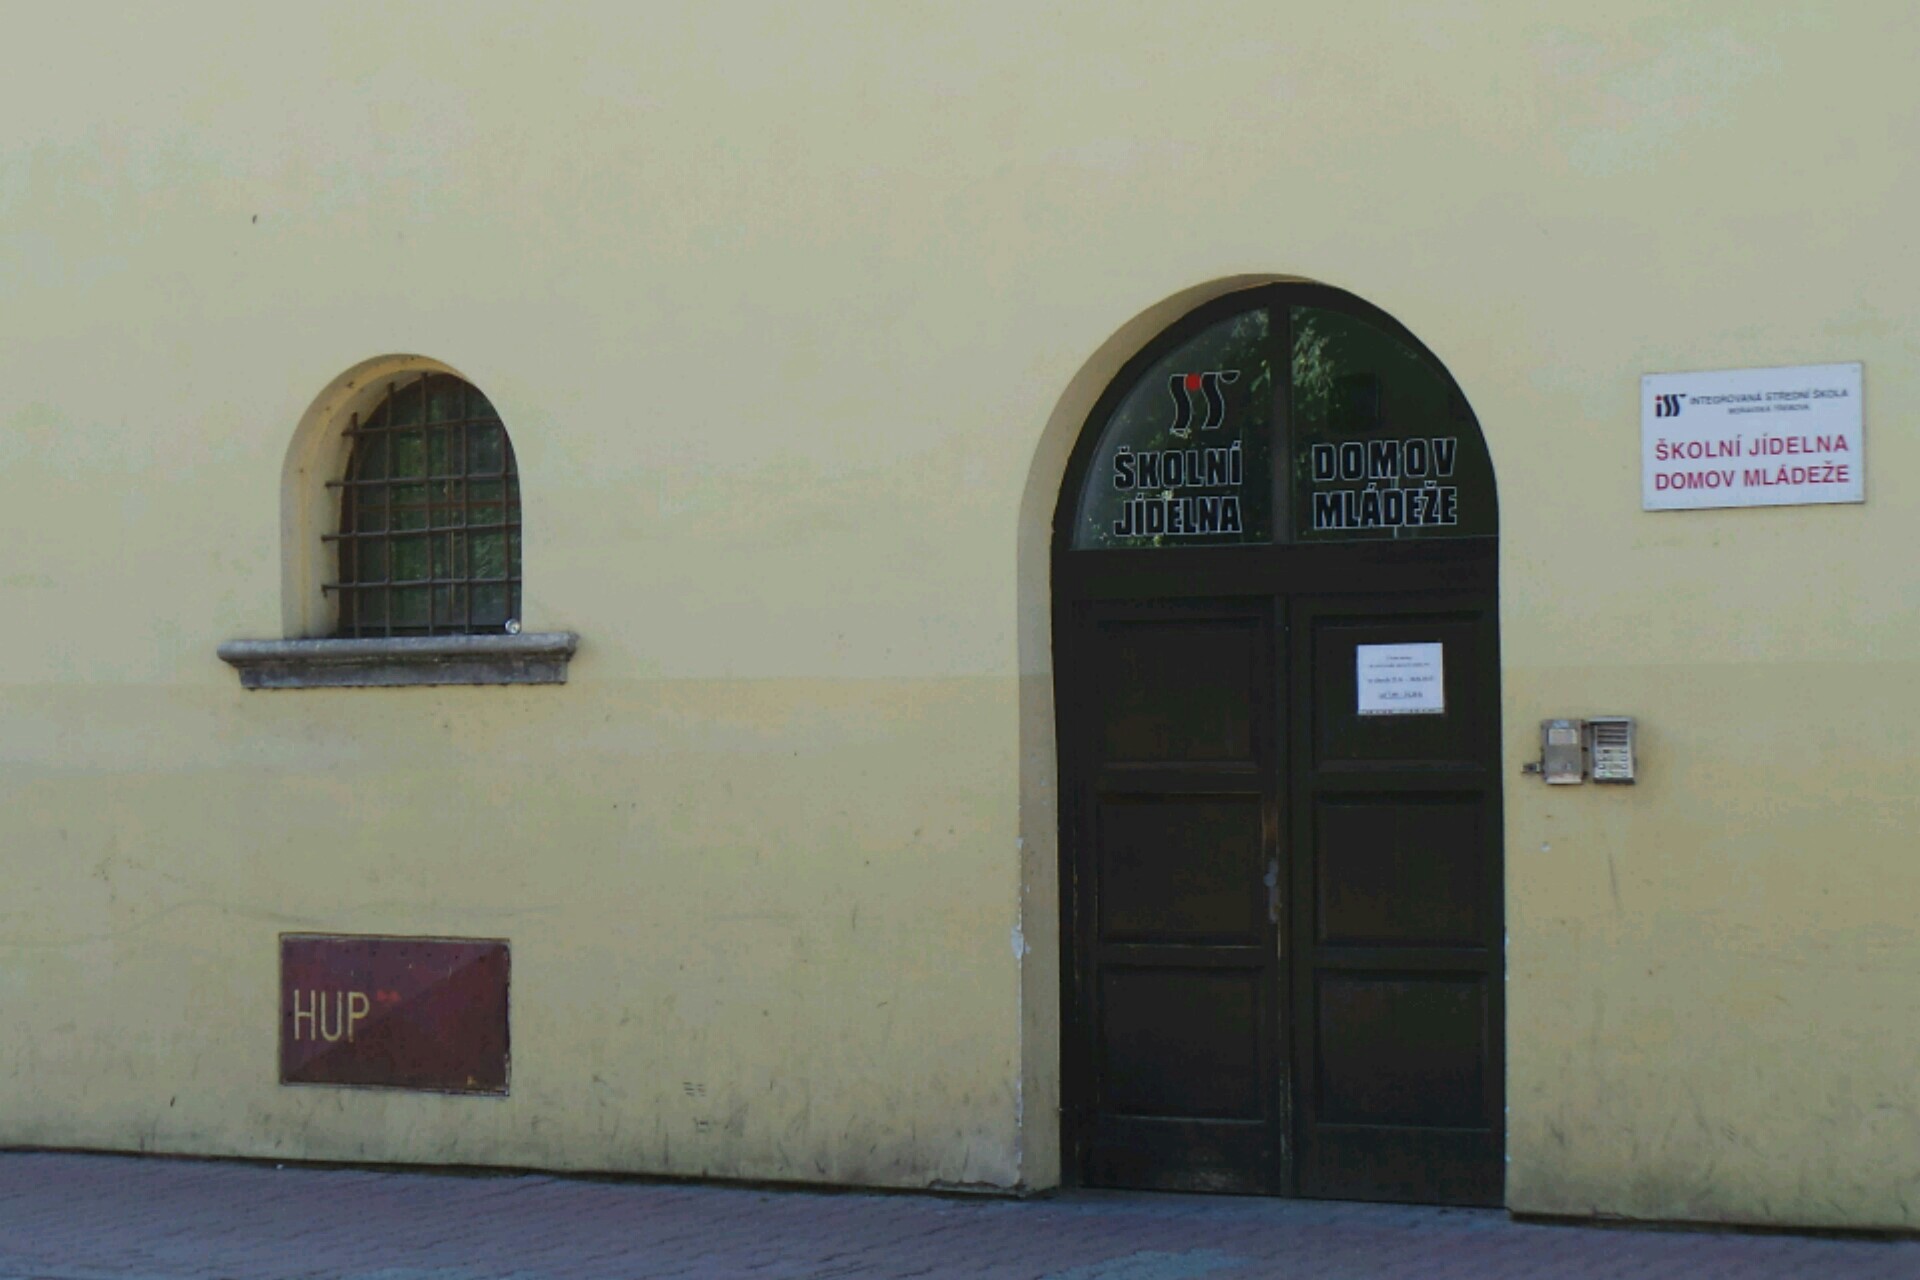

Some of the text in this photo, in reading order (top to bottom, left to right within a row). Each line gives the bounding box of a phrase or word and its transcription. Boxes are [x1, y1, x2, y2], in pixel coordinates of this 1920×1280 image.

[1812, 387, 1848, 399] ŠKOLA
[1114, 441, 1243, 489] ŠKOLNÍ
[1312, 438, 1457, 481] DOMOV
[1656, 433, 1849, 460] ŠKOLNÍ JÍDELNA
[1656, 461, 1849, 490] DOMOV MLÁDEŽE
[1114, 493, 1243, 536] JÍDELNA
[1313, 481, 1457, 529] MLÁDEŽE
[294, 989, 370, 1042] HUP
